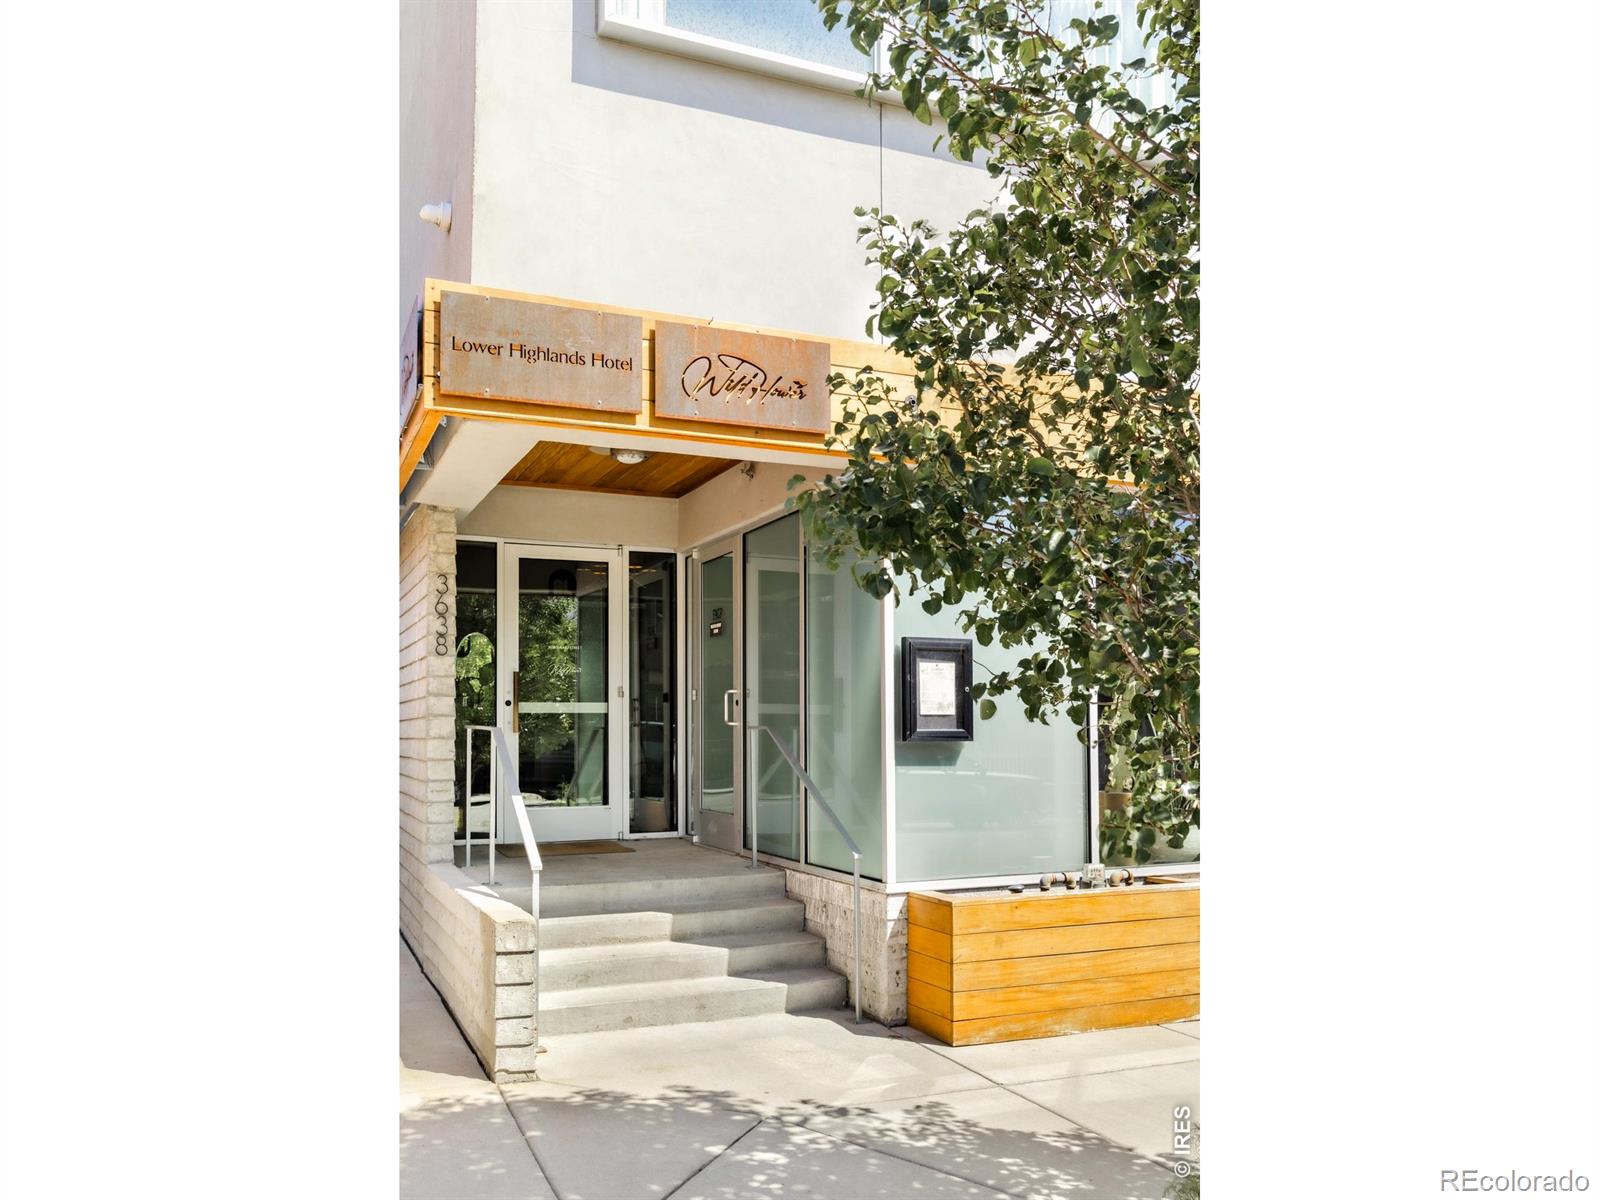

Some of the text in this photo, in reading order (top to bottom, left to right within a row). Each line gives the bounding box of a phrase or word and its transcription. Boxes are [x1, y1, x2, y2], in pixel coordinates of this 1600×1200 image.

[452, 336, 633, 371] Lower Highlands Hotel
[434, 574, 449, 656] 3638
